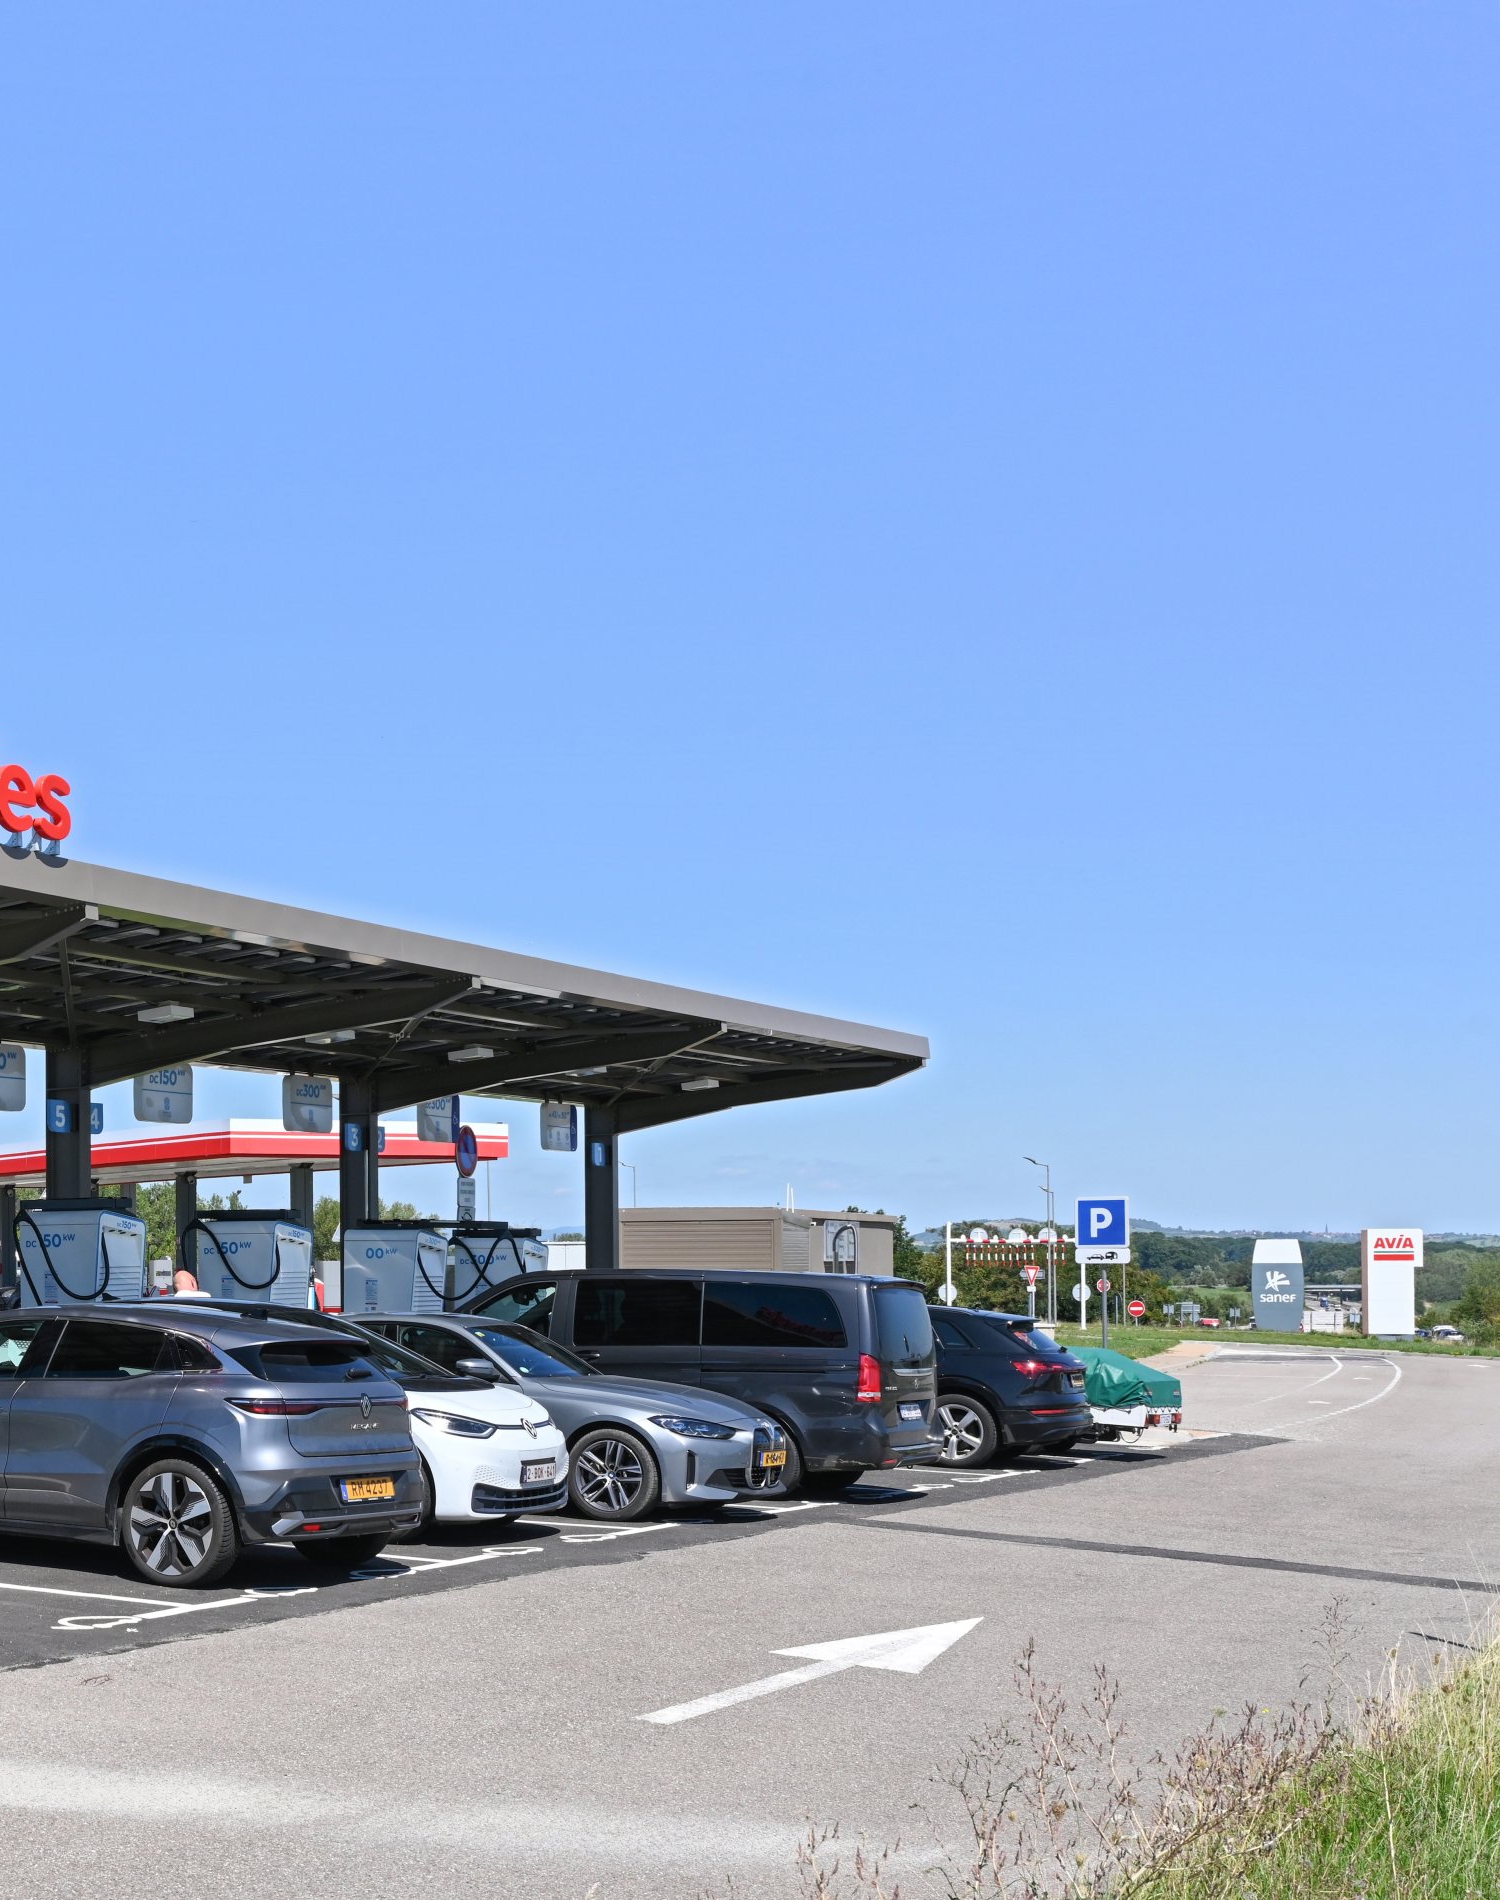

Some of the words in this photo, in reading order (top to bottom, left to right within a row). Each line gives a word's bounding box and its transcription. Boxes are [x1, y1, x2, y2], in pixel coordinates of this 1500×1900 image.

[55, 1105, 66, 1128] 5
[90, 1108, 100, 1129] 4
[351, 1127, 359, 1147] 3
[1090, 1207, 1113, 1238] P
[25, 1240, 37, 1248] DC
[39, 1233, 62, 1248] 50
[62, 1233, 76, 1242] kW
[203, 1247, 215, 1255] DC
[216, 1241, 239, 1255] 50
[239, 1241, 252, 1249] kW
